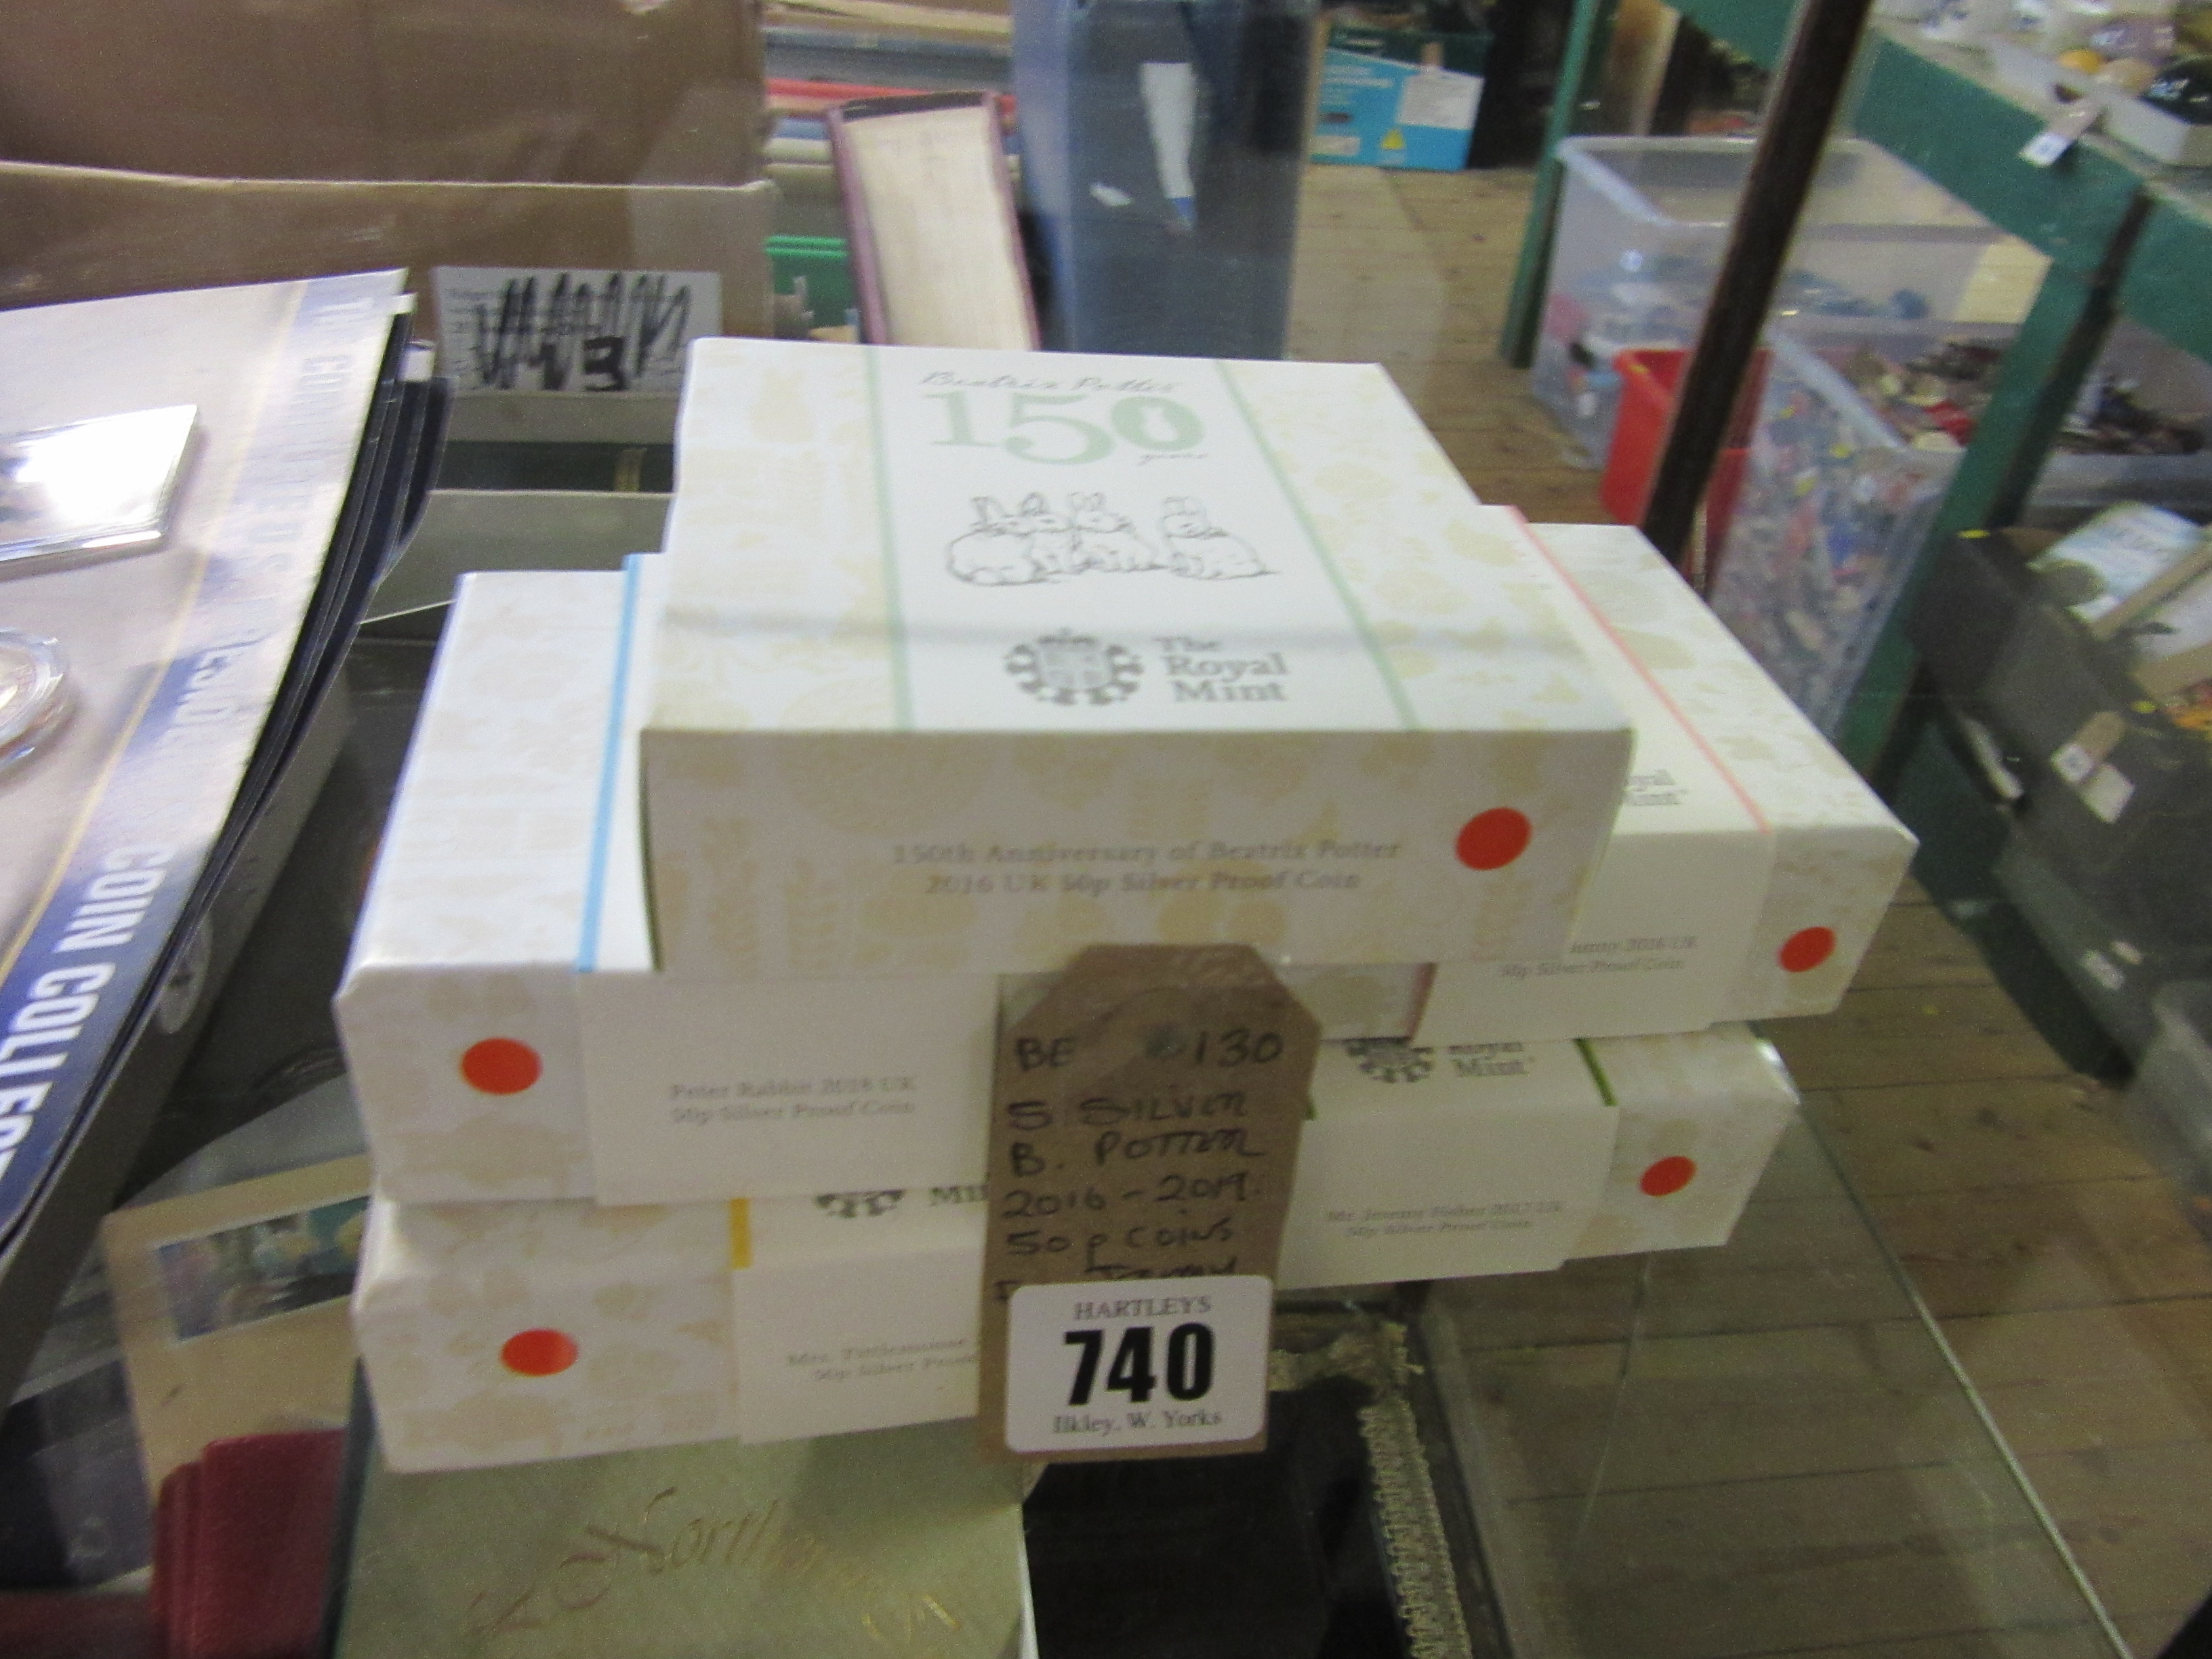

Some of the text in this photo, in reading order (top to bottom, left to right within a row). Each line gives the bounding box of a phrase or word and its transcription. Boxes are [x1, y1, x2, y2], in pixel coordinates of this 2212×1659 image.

[923, 390, 1206, 465] 150
[1153, 636, 1220, 652] The
[1160, 651, 1288, 682] Royal
[1171, 679, 1288, 702] Mint
[893, 838, 1401, 867] 150th Anniversary of Beatrix Potter
[925, 874, 995, 895] 2016
[1120, 872, 1202, 893] Silver
[1209, 870, 1289, 891] Proof
[1292, 869, 1360, 890] Coin
[54, 842, 175, 952] COIN
[669, 1084, 729, 1101] Peter
[737, 1078, 812, 1098] Rabbit
[1073, 1295, 1214, 1320] HARTLEYS
[1064, 1322, 1215, 1406] 740
[1161, 1408, 1221, 1429] Yorks
